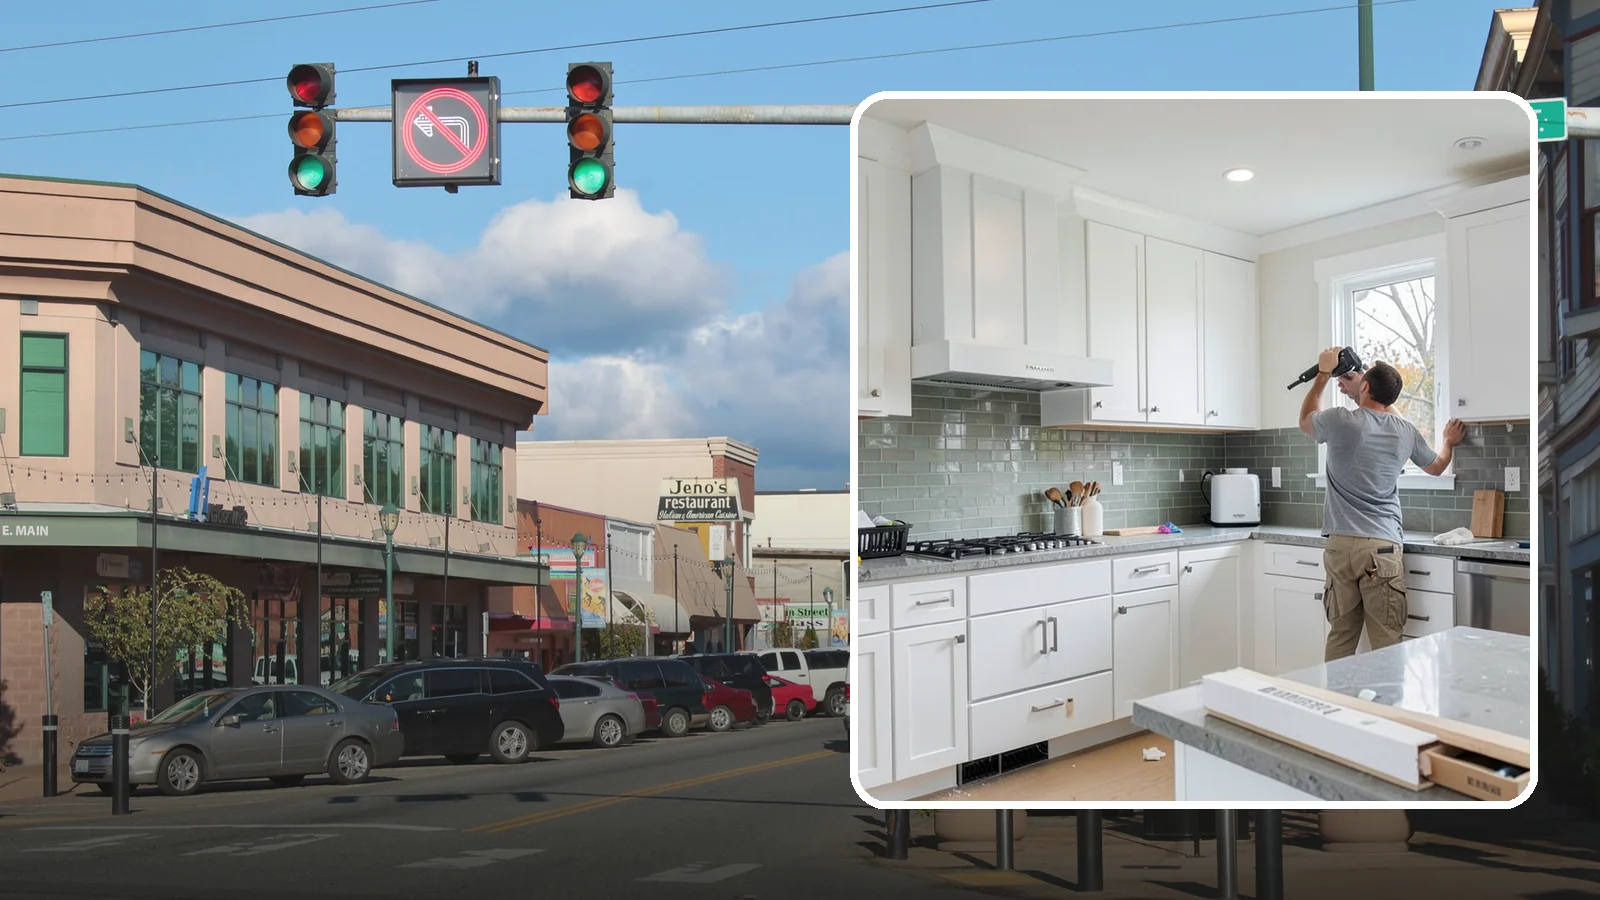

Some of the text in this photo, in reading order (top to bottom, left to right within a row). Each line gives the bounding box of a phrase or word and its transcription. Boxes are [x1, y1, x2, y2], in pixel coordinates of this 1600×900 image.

[669, 480, 728, 495] Jeno's
[665, 496, 731, 509] restaurant
[658, 509, 682, 520] Italian
[686, 509, 715, 519] American
[715, 509, 738, 519] Cuisine
[2, 525, 49, 536] E. MAIN
[785, 607, 795, 617] in
[797, 607, 828, 617] Street
